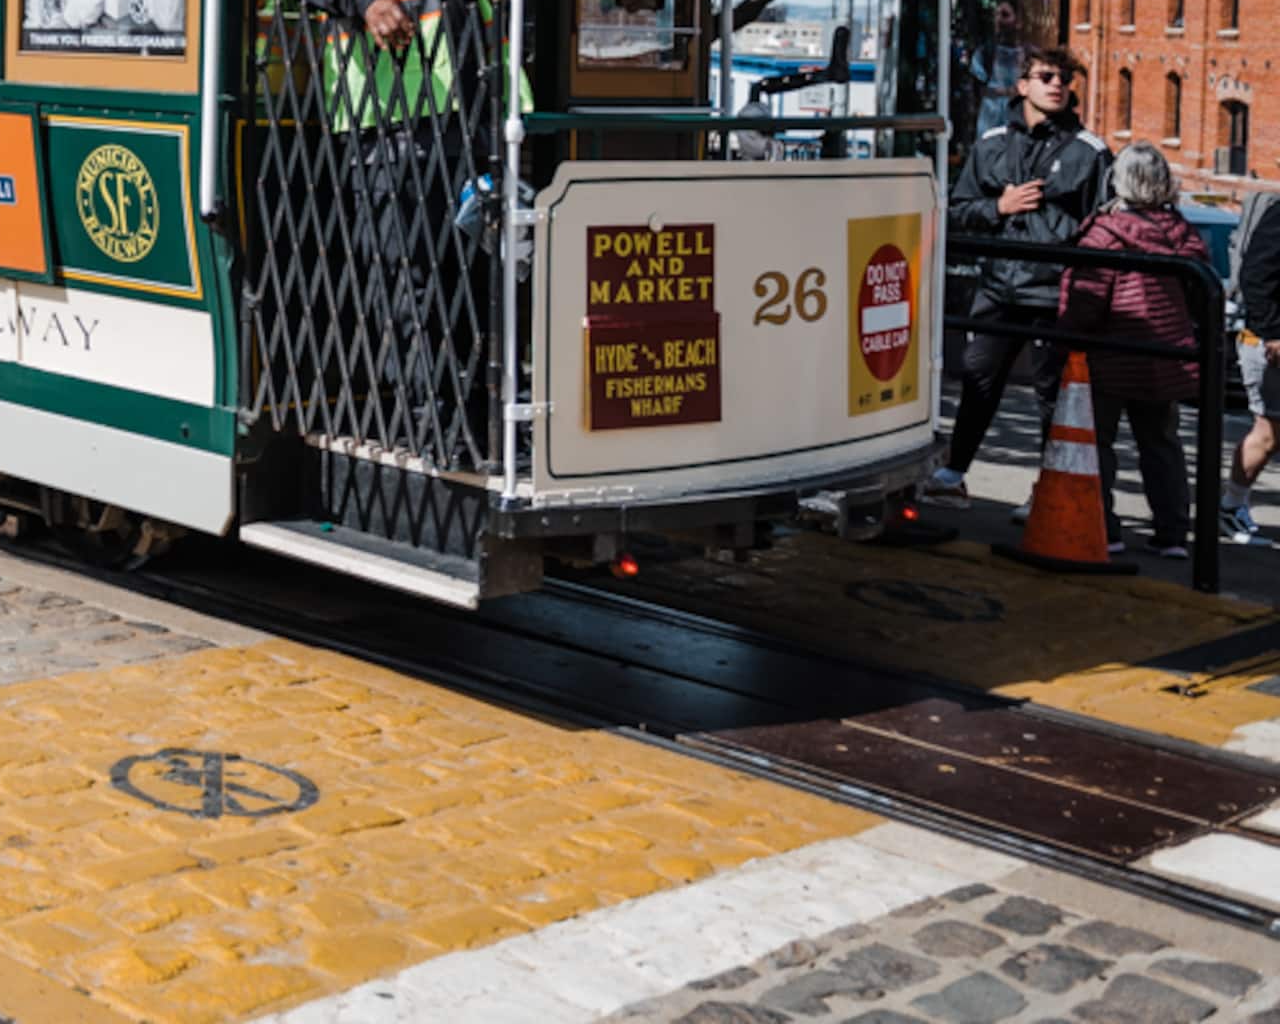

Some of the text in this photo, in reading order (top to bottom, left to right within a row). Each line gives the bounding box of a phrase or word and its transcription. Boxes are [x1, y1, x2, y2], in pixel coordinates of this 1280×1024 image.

[80, 147, 152, 191] MUNICIPAL
[99, 171, 133, 236] SF
[84, 216, 154, 258] RAILWAY
[593, 232, 711, 257] POWELL
[626, 257, 685, 277] AND
[867, 261, 907, 286] DO NOT
[590, 276, 712, 304] MARKET
[753, 267, 827, 326] 26
[873, 282, 902, 303] PASS
[595, 343, 639, 373] HYDE
[663, 338, 716, 368] BEACH
[862, 332, 892, 354] CABLE
[605, 372, 707, 399] FISHERMANS
[631, 396, 684, 417] WHARF
